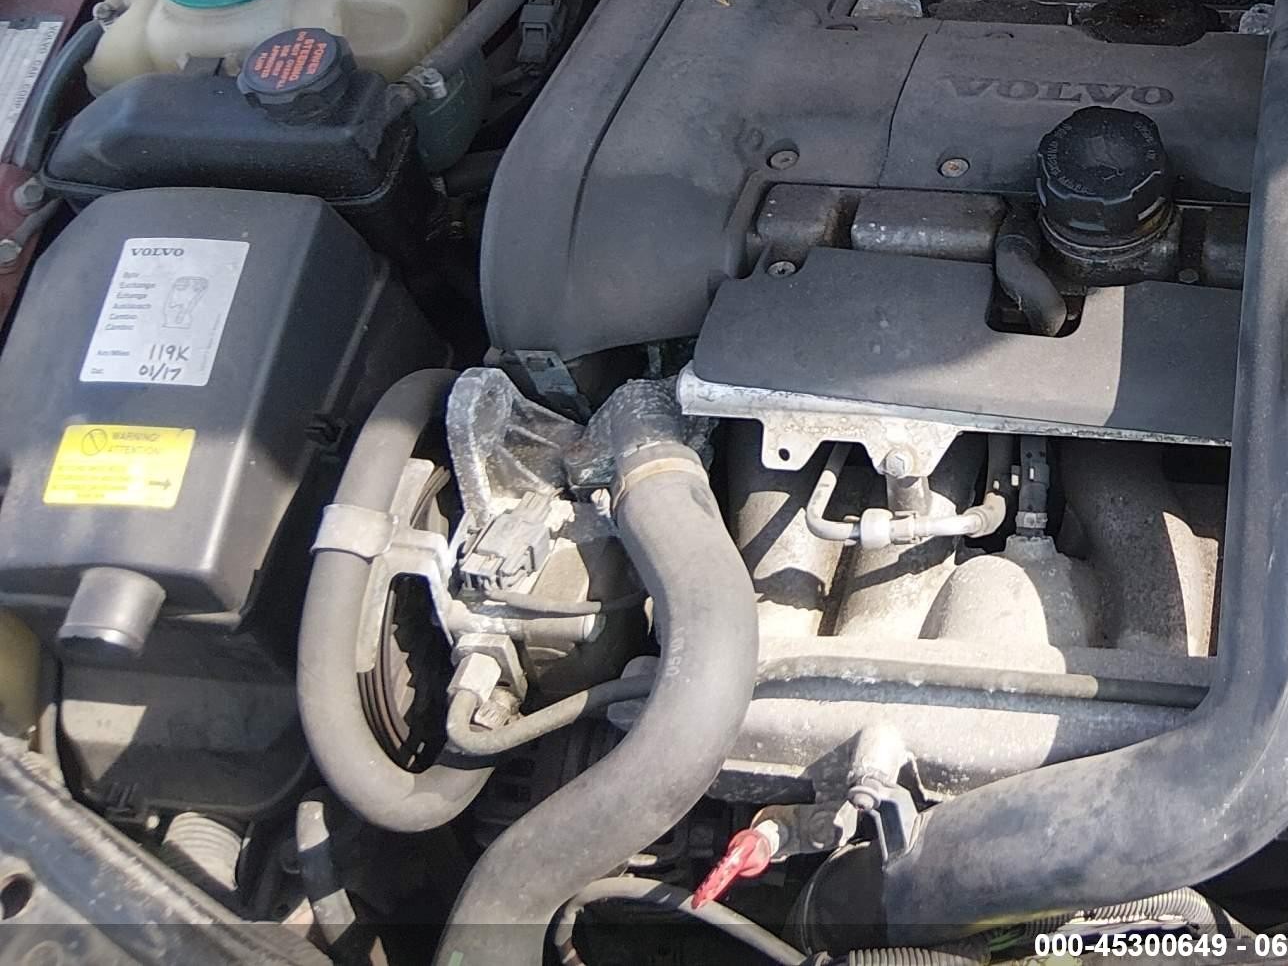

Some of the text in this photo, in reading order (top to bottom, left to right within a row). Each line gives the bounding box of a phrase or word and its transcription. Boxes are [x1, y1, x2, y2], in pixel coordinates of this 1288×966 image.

[289, 38, 315, 82] STEERING
[306, 43, 327, 74] POWER
[942, 76, 1174, 107] VOLVO
[131, 247, 185, 257] VOLVO
[149, 344, 191, 362] 119K
[138, 363, 182, 381] 01/17
